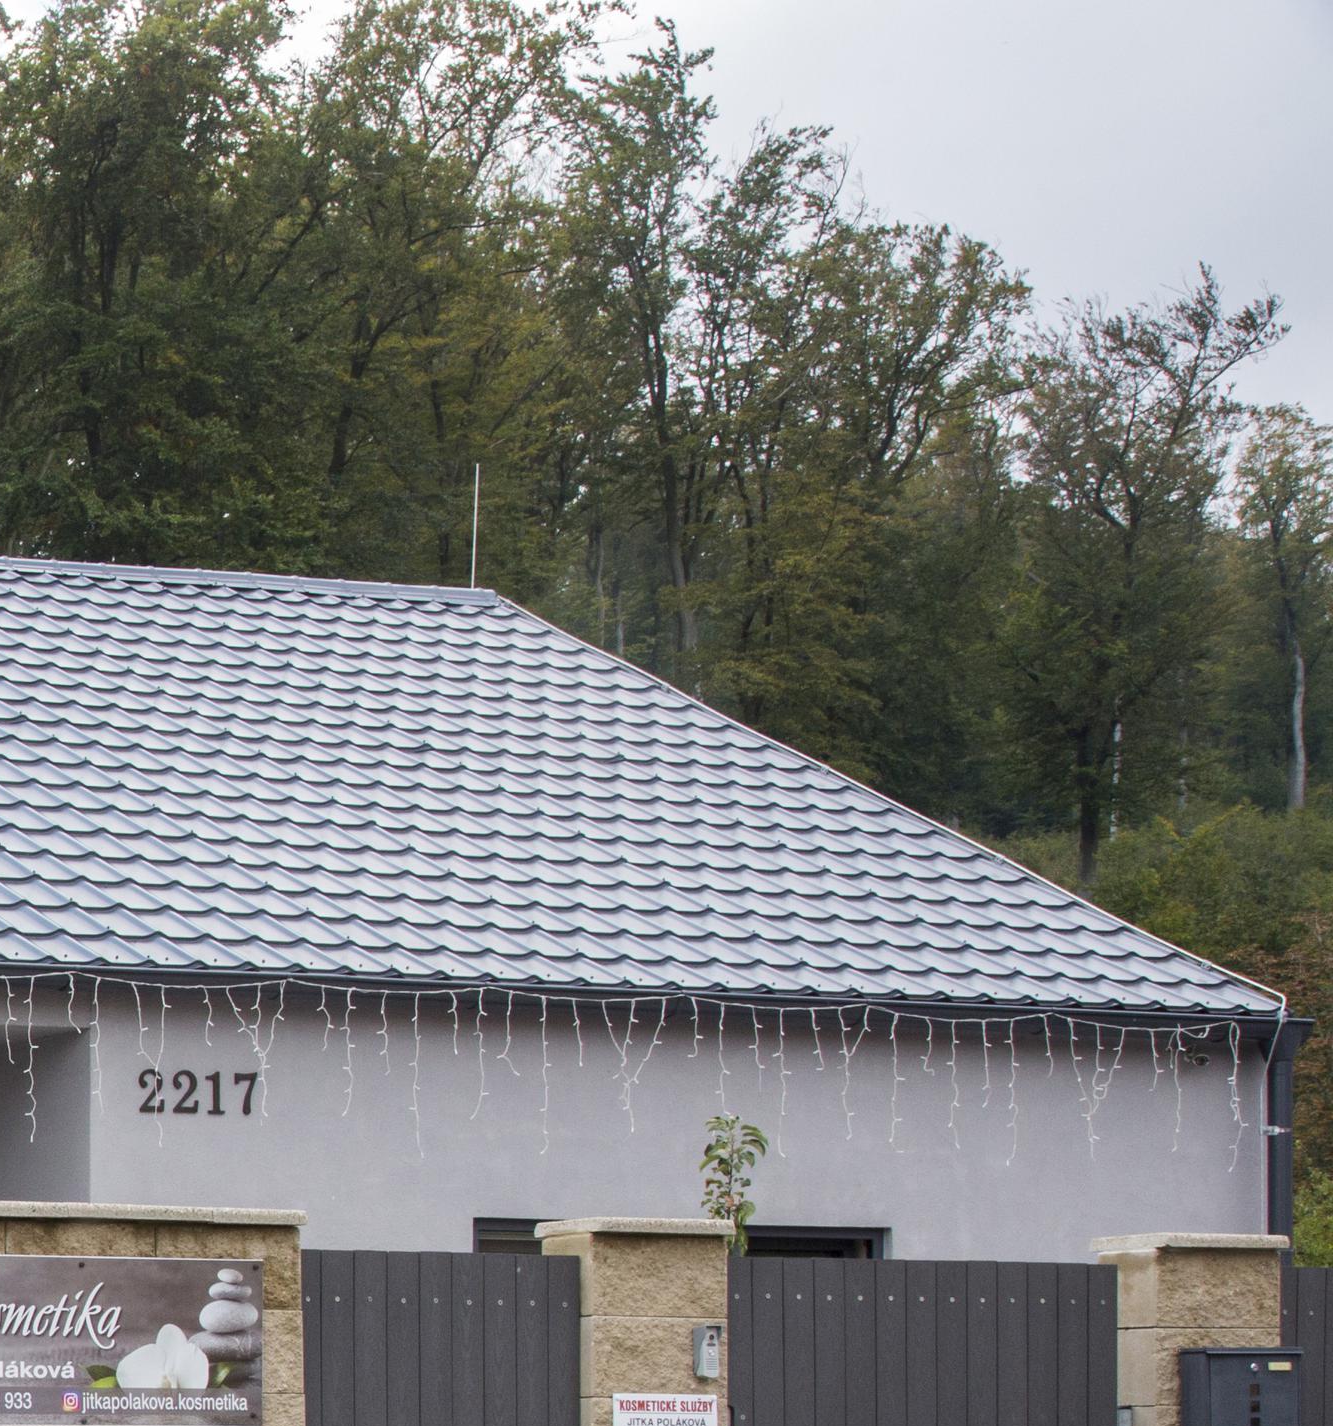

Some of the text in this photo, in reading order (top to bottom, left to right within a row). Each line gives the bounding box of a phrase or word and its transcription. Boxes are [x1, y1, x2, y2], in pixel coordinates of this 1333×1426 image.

[138, 1068, 258, 1116] 2217
[4, 1391, 32, 1409] 933
[82, 1392, 248, 1413] jitkapolakova.kosmetika
[619, 1397, 713, 1413] KOSMETICKÉ SLUŽBY
[627, 1416, 707, 1426] JITKA POLÁKOVÁ
